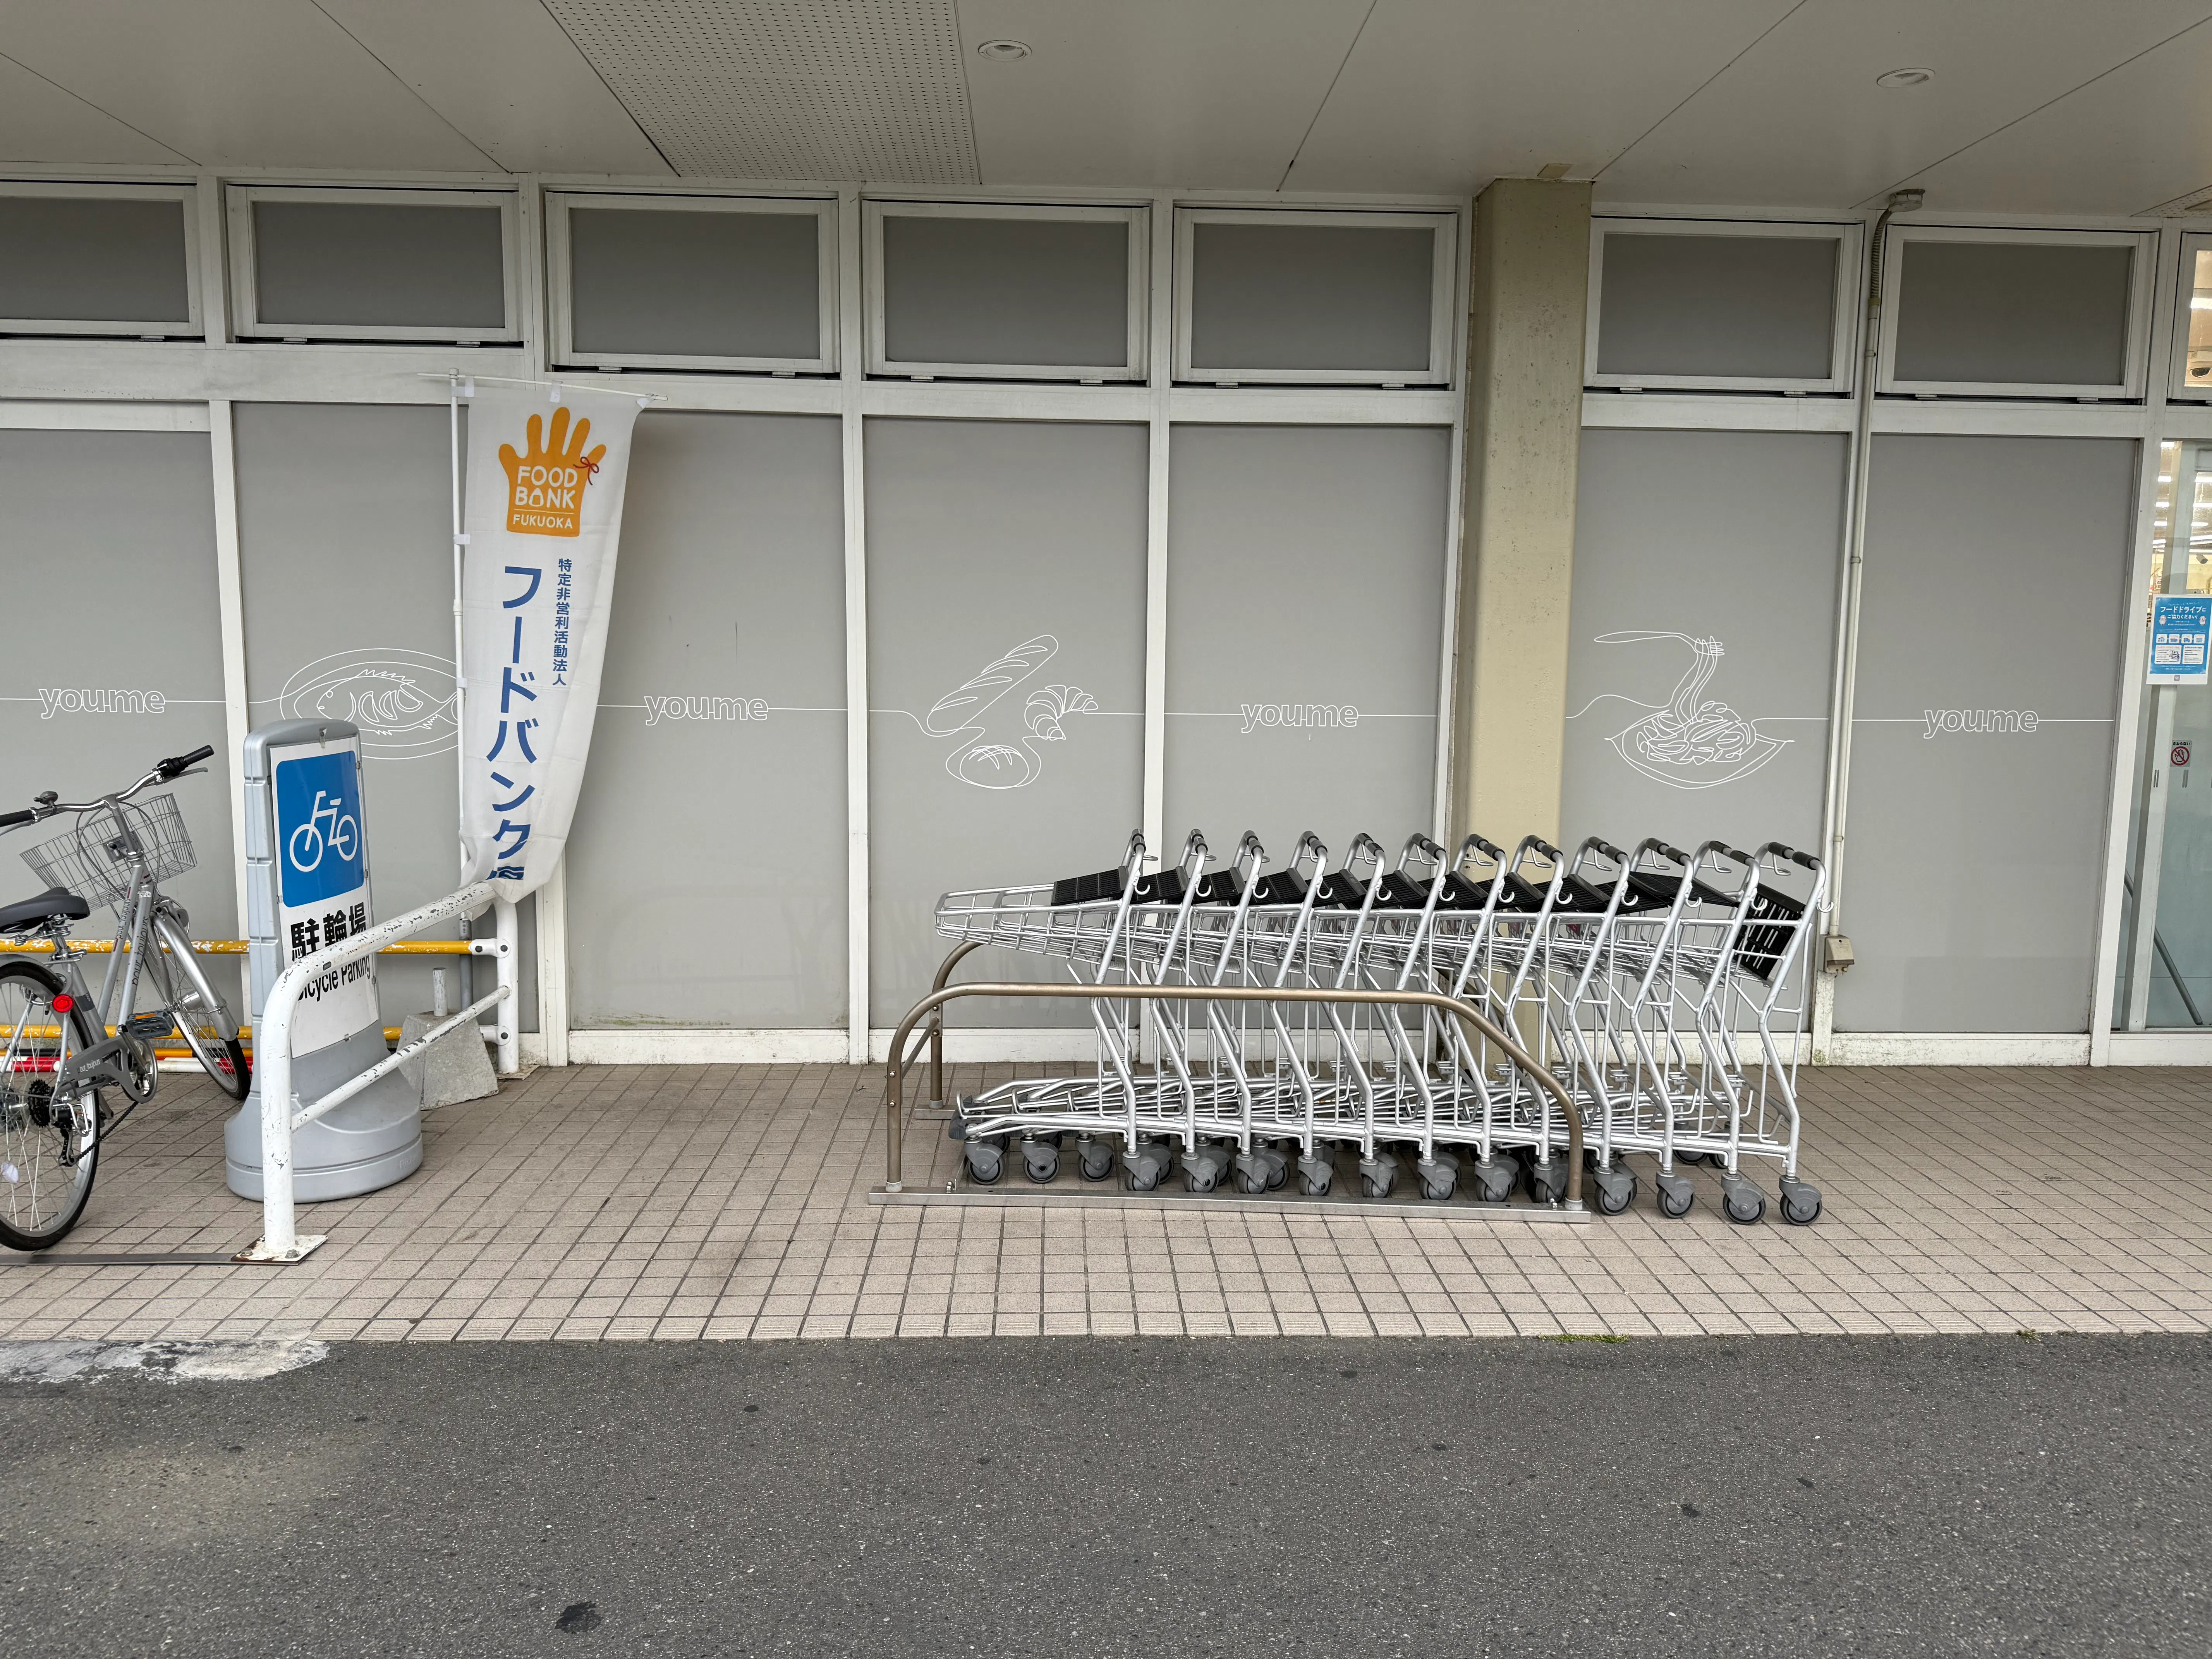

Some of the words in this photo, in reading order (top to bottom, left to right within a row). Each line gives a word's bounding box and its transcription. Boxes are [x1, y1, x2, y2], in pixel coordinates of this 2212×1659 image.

[517, 465, 578, 488] FOOD
[515, 486, 575, 509] BANK
[513, 514, 573, 529] FUKUOKA
[552, 558, 572, 686] 特定非営利活動法人
[39, 689, 166, 719] youme
[644, 696, 769, 726] youme
[1241, 704, 1359, 733] youme
[1923, 710, 2039, 739] youme
[298, 970, 338, 1002] icycle
[341, 955, 370, 986] Parking
